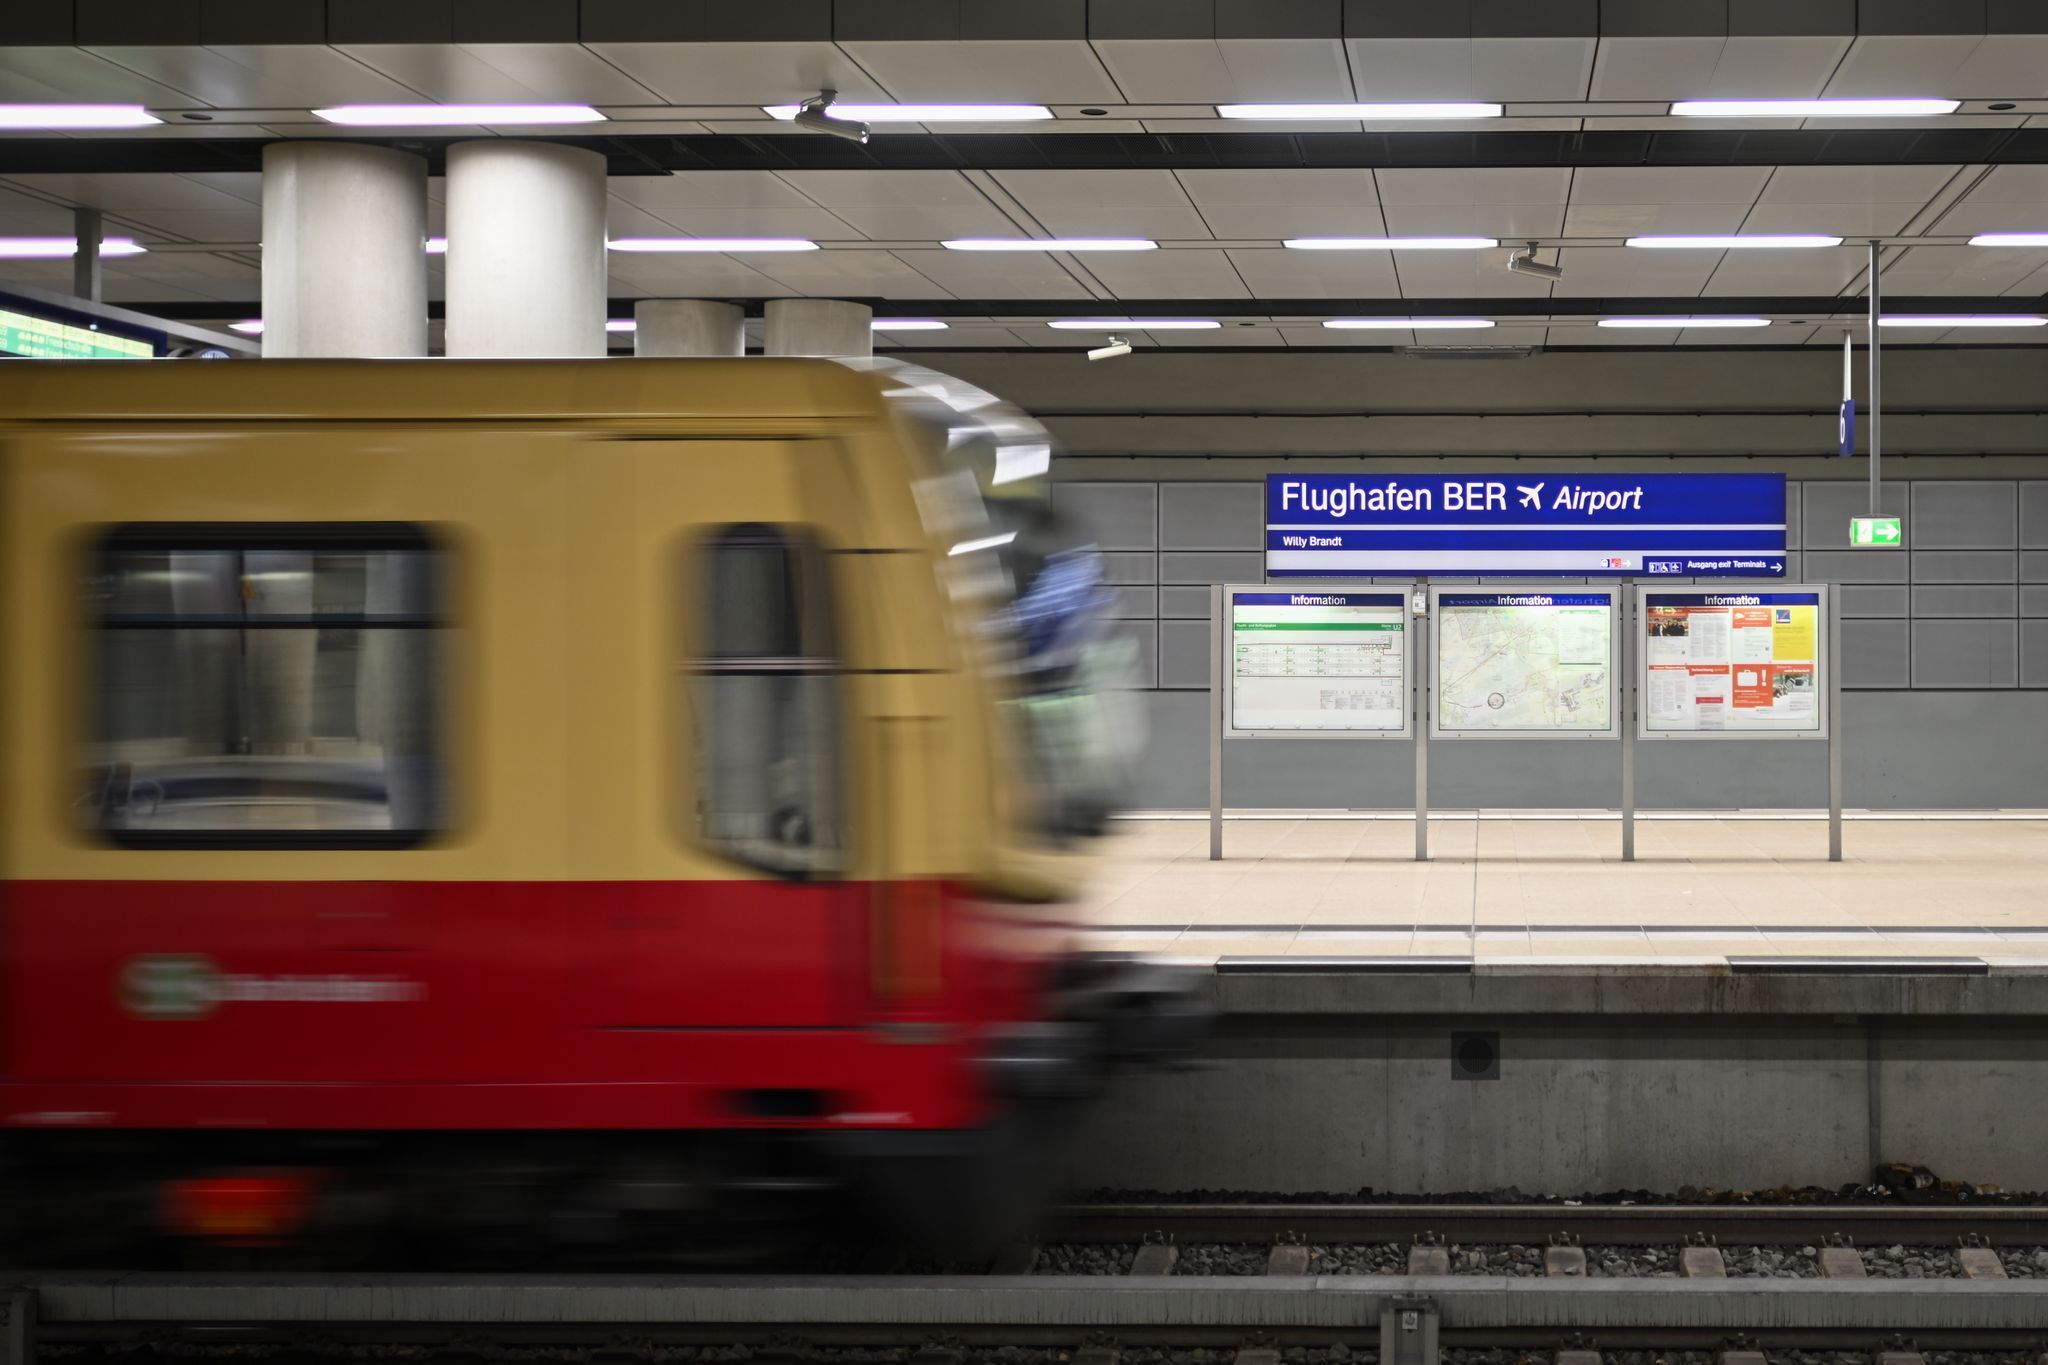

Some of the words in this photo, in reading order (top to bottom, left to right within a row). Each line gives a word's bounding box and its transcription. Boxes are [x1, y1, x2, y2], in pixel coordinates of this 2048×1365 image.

[1840, 403, 1846, 444] 6
[1282, 482, 1432, 517] Flughafen
[1443, 482, 1507, 511] BER
[1552, 485, 1644, 515] Airport
[1283, 536, 1307, 549] Willy
[1309, 535, 1343, 547] Brandt
[1687, 560, 1717, 570] Ausgang
[1733, 560, 1767, 569] Terminals
[1291, 594, 1346, 606] Information
[1497, 595, 1553, 606] Information
[1704, 595, 1760, 606] Information
